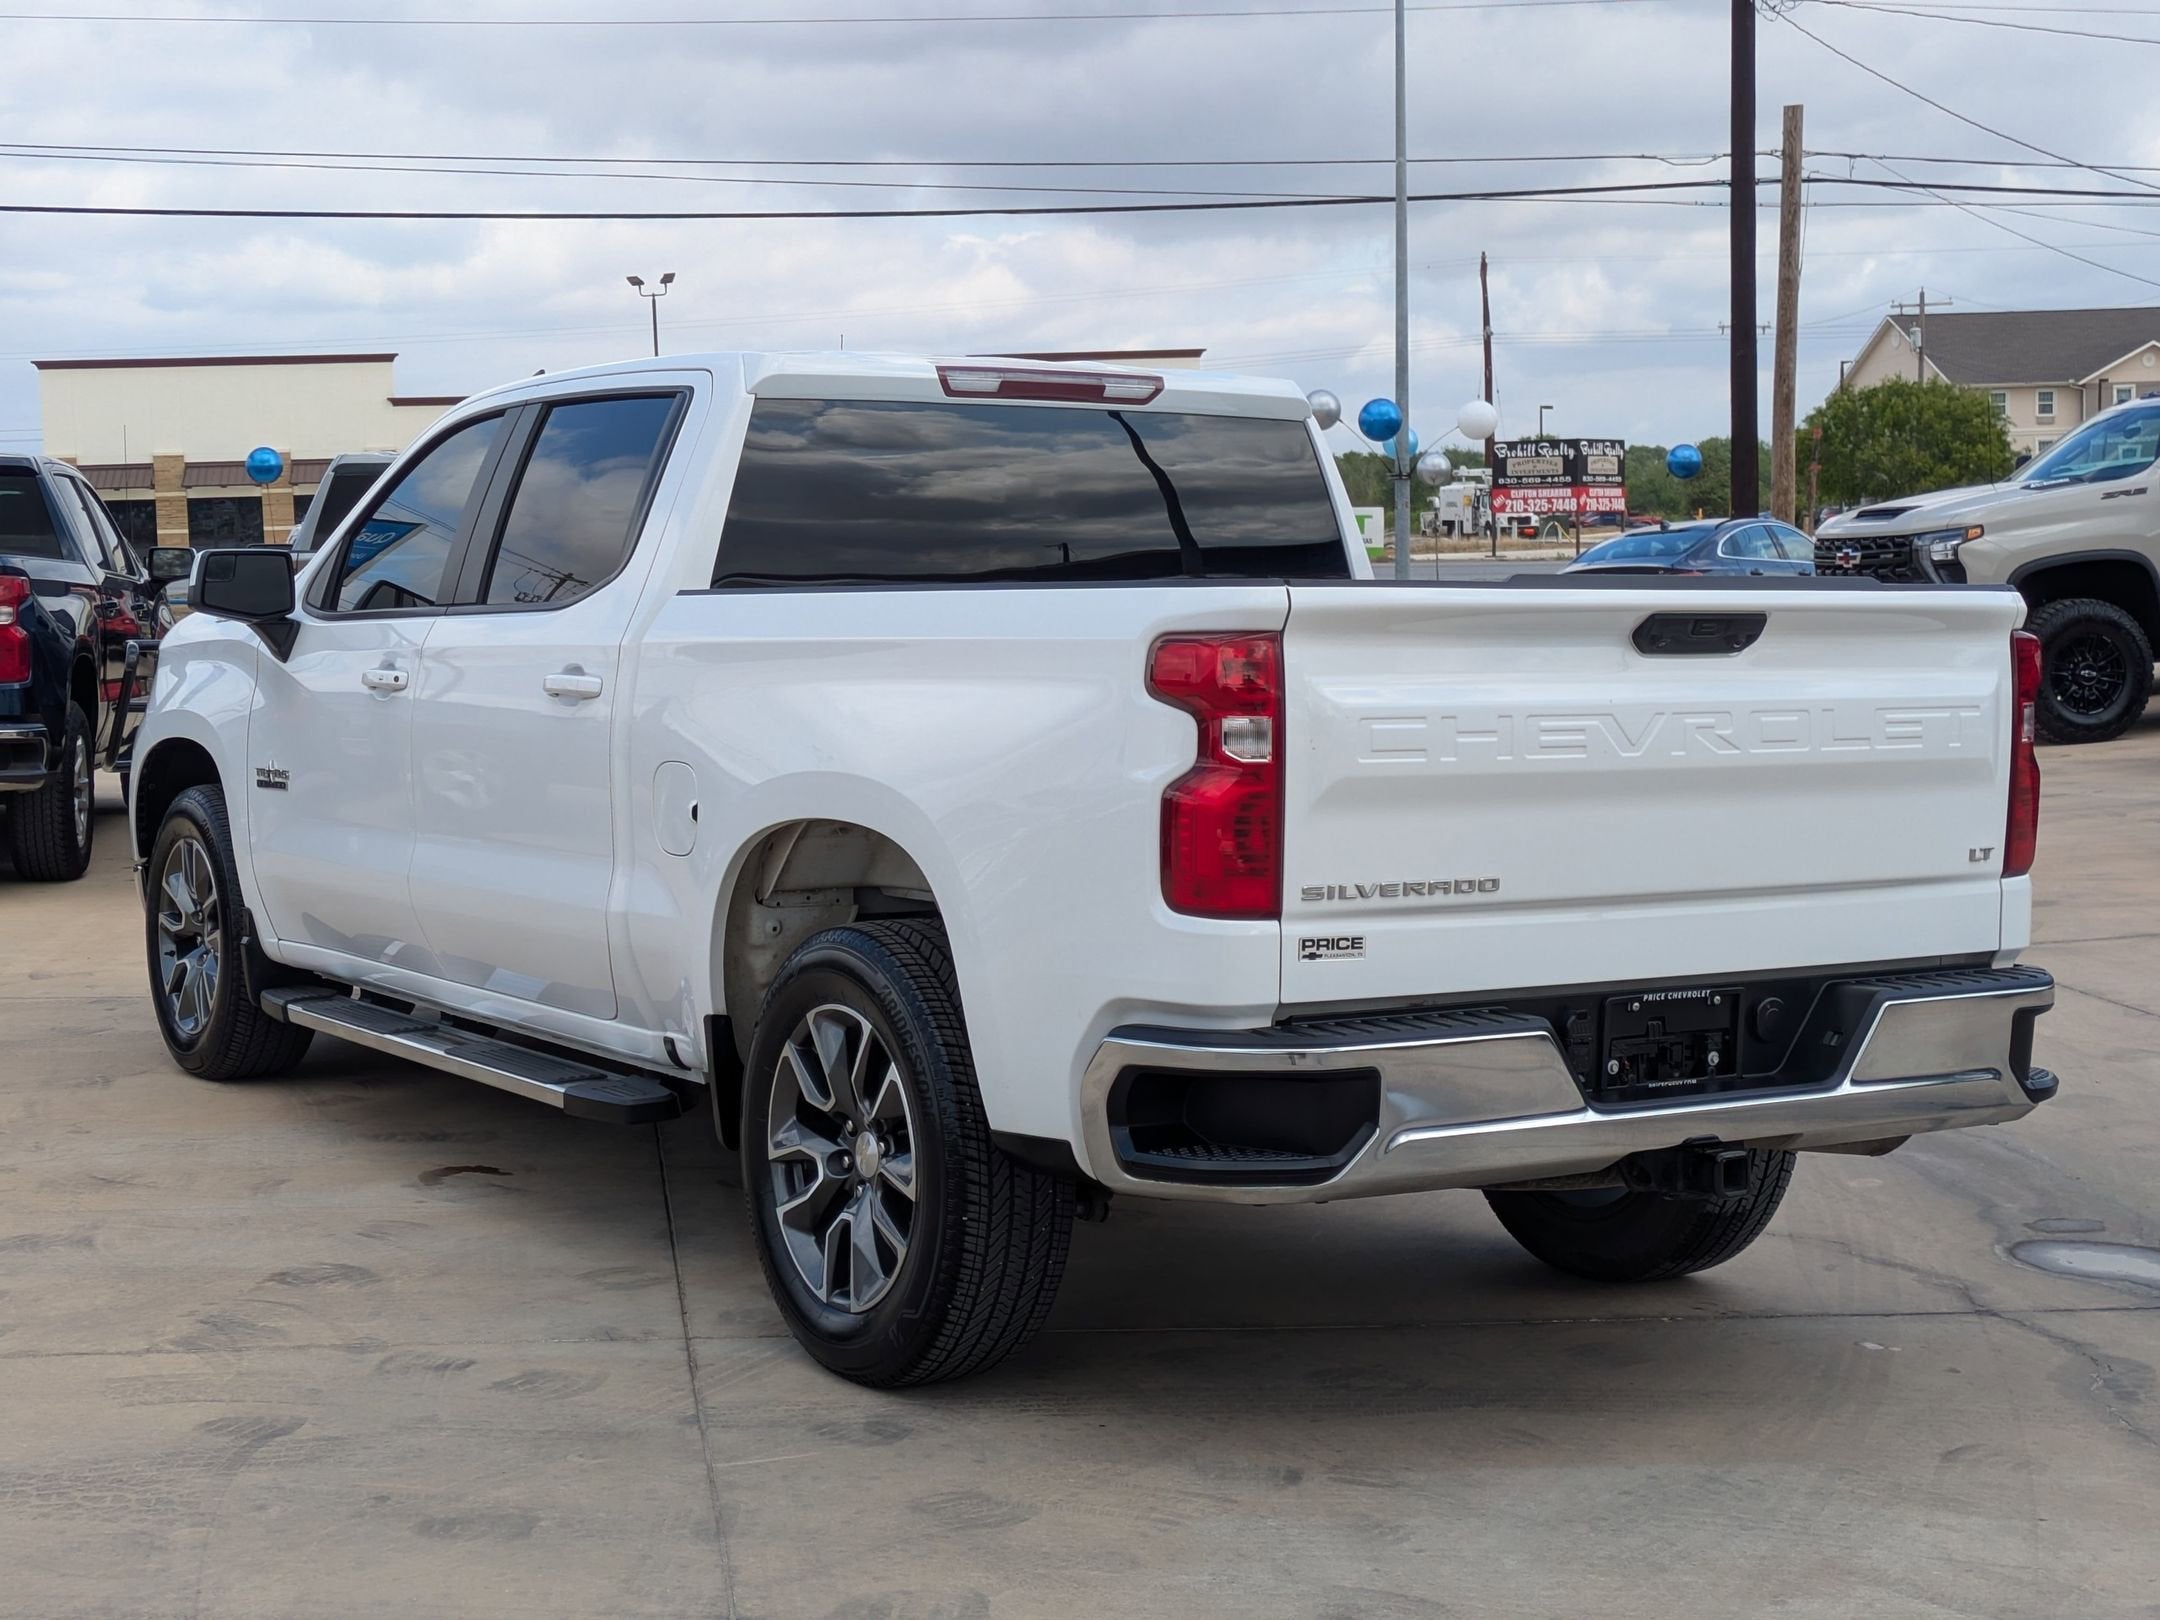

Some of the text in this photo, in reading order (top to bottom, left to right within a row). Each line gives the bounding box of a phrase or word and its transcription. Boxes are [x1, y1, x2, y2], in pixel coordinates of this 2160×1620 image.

[1505, 498, 1578, 513] 210-325-7448
[1358, 705, 1981, 763] CHEVROLET
[1969, 847, 1995, 862] LT
[1301, 877, 1500, 901] SILVERADO
[1301, 937, 1363, 951] PRICE
[1643, 989, 1711, 1002] PRICE CHEVROLET
